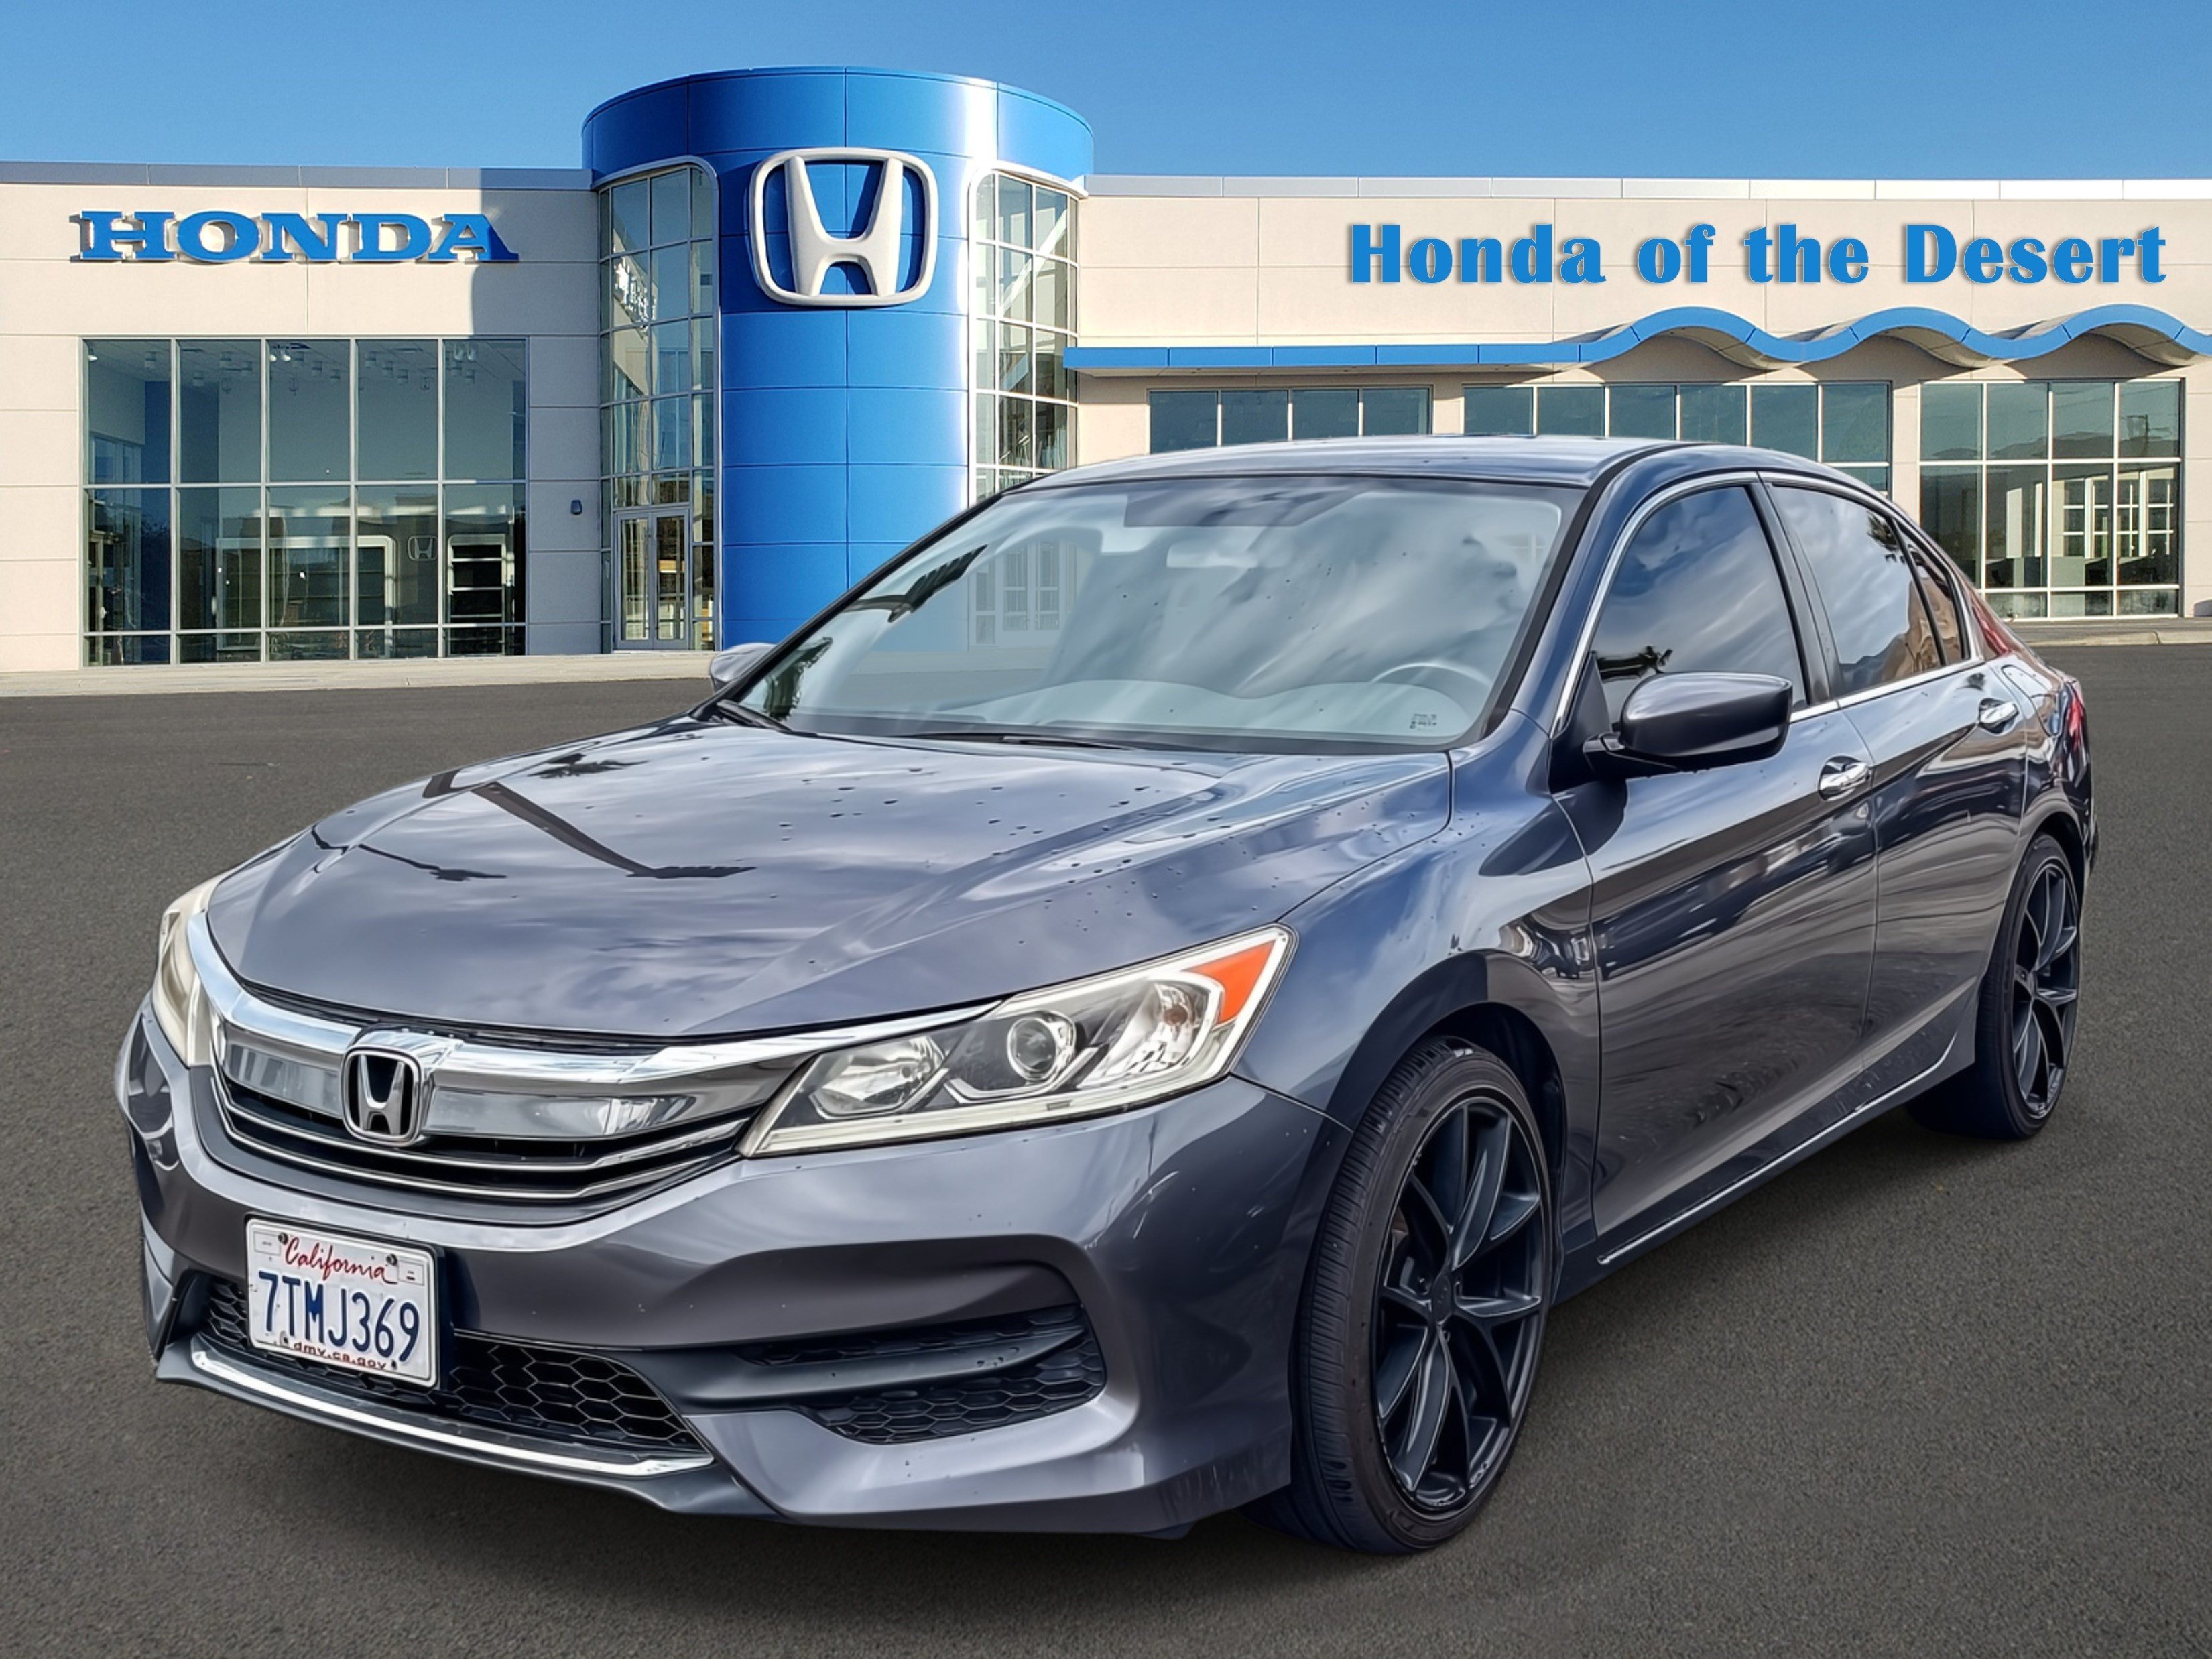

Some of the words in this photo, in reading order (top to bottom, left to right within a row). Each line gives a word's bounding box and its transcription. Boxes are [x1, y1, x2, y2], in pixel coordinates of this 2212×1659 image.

[81, 210, 519, 261] HONDA
[1351, 223, 1607, 284] Honda
[1637, 223, 1717, 284] of
[1744, 223, 1869, 284] the
[1906, 224, 2167, 284] Desert
[284, 1237, 398, 1285] California
[258, 1270, 420, 1363] 7TMJ369
[293, 1341, 387, 1369] dmv.ca.gov
